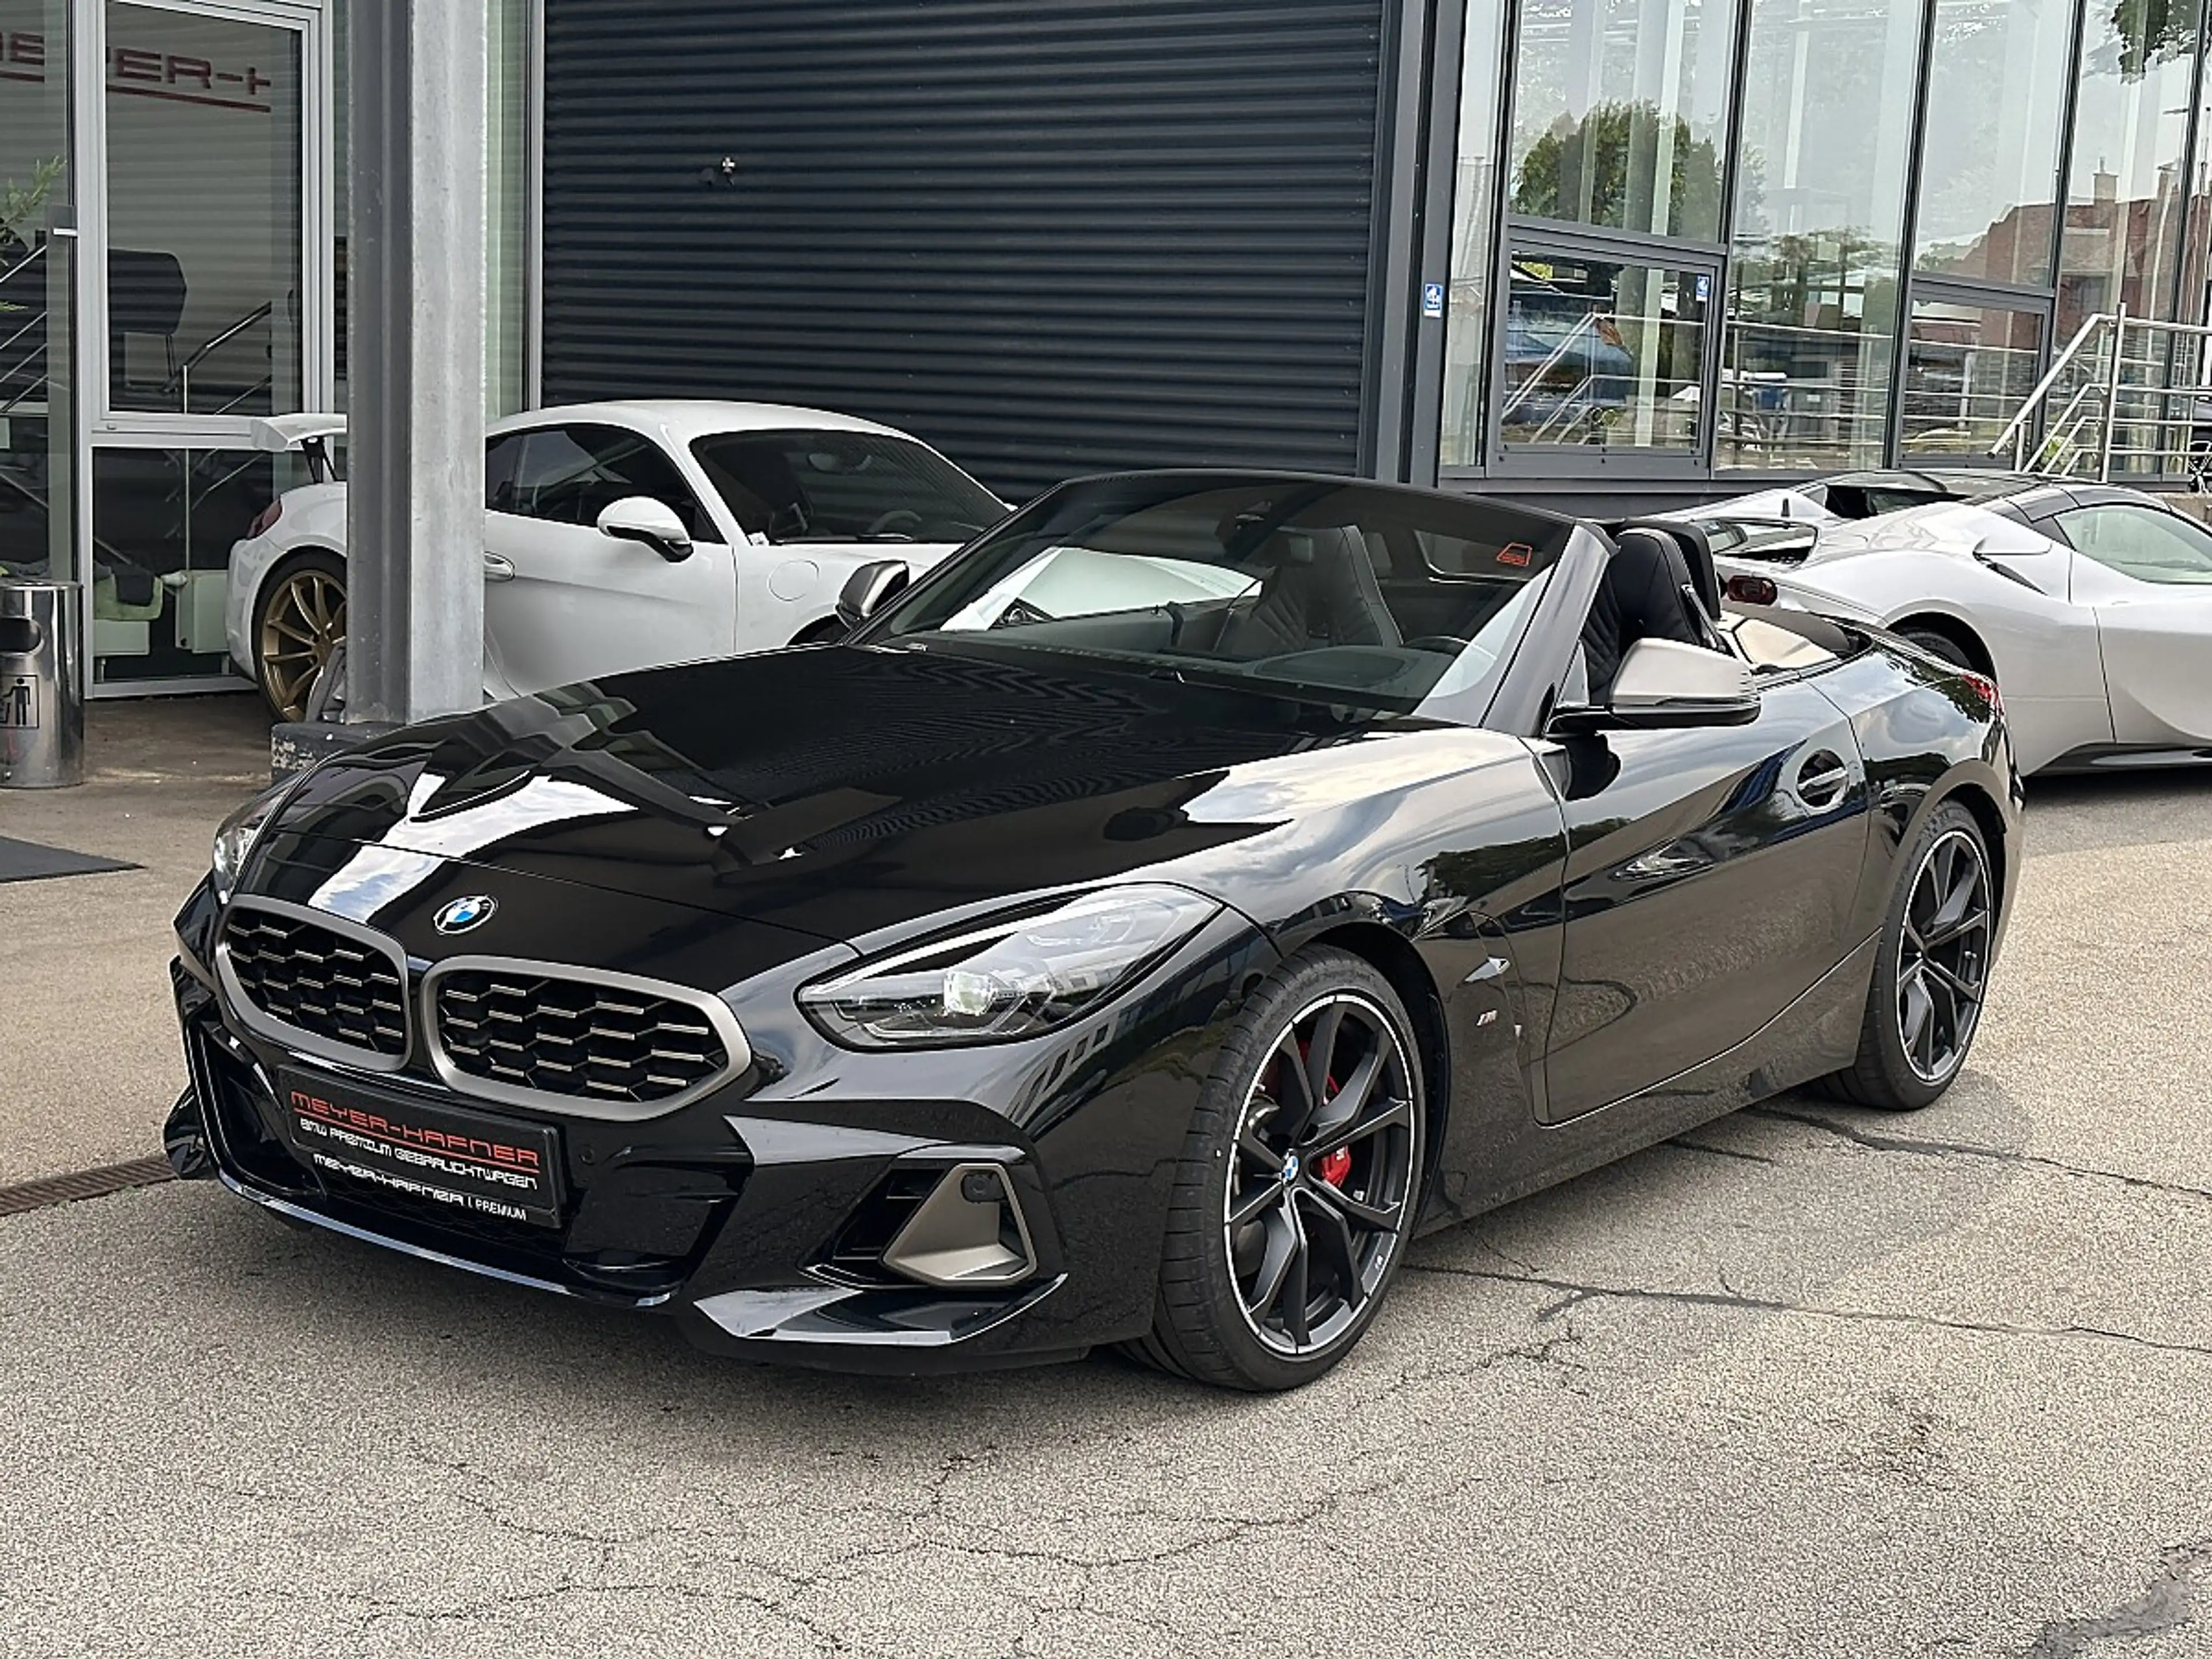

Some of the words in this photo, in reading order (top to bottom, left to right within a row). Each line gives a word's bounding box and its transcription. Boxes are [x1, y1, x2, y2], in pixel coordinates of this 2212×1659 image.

[290, 1090, 539, 1166] MEYER-HAFNER
[300, 1116, 328, 1137] BMW
[329, 1127, 392, 1157] PREMIUM
[393, 1147, 538, 1191] GEBRAUCHTWAGEN
[313, 1153, 464, 1207] MEYER-HAFNER
[475, 1198, 527, 1221] PREMIUM
